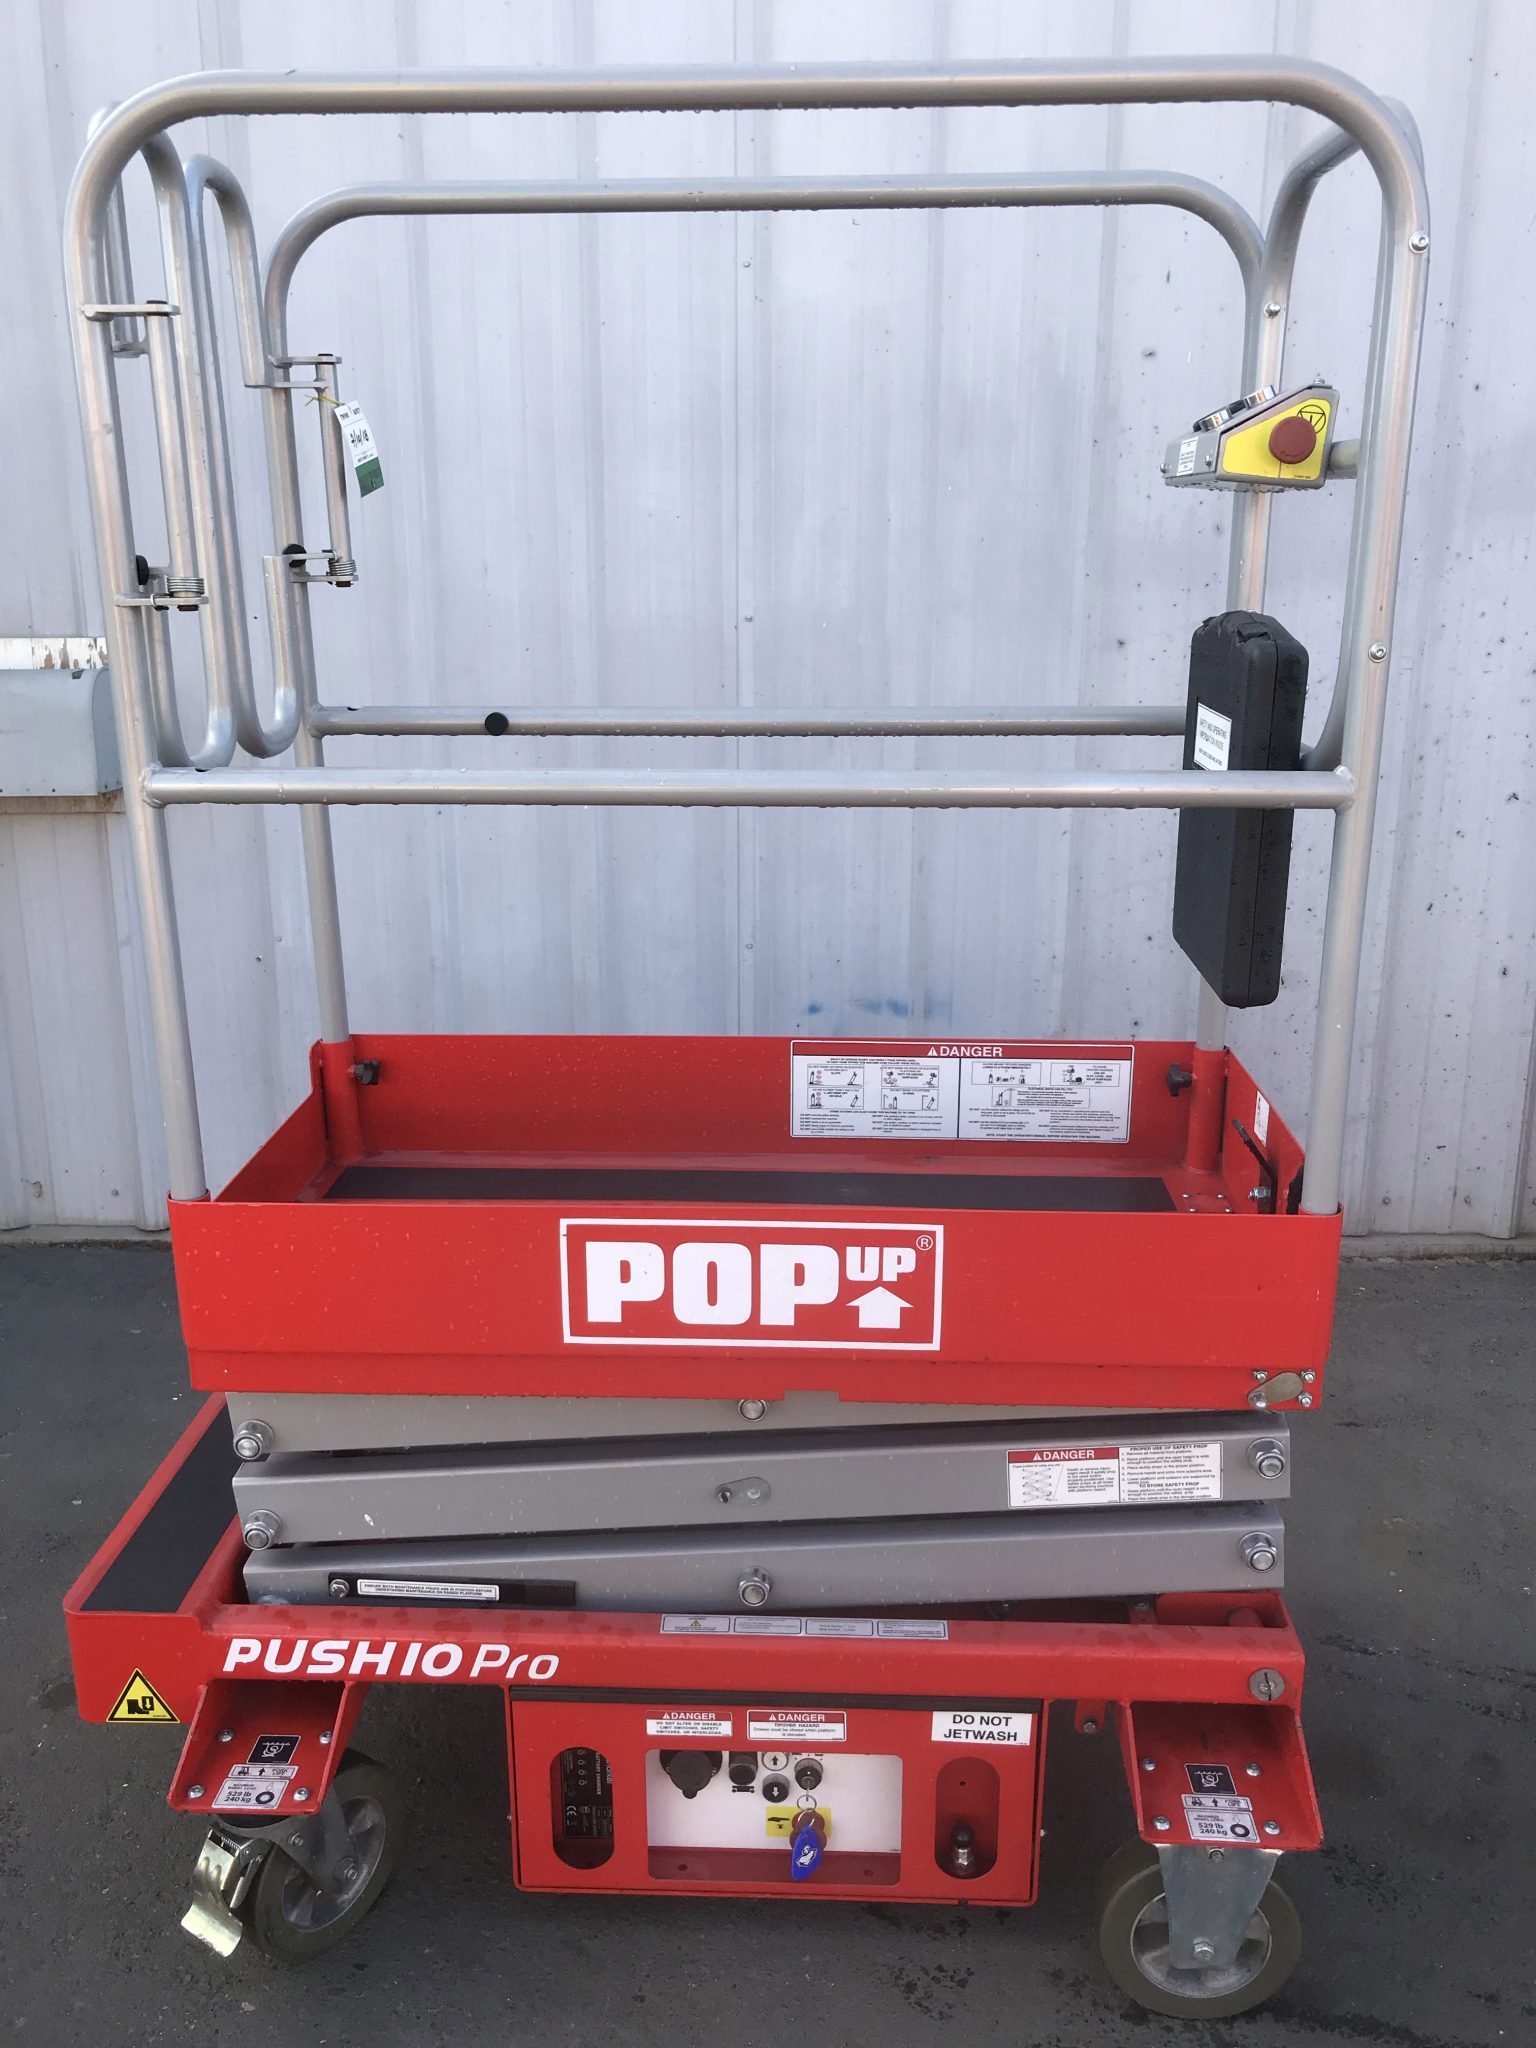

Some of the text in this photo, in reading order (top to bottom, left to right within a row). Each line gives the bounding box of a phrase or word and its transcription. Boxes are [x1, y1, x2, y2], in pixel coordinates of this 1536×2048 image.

[940, 1046, 1003, 1058] DANGER
[845, 1246, 916, 1282] UP
[585, 1241, 839, 1326] POP
[1043, 1450, 1094, 1460] DANGER
[469, 1643, 560, 1680] Pro
[953, 1714, 1012, 1726] DO NOT
[944, 1728, 1017, 1741] JETWASH
